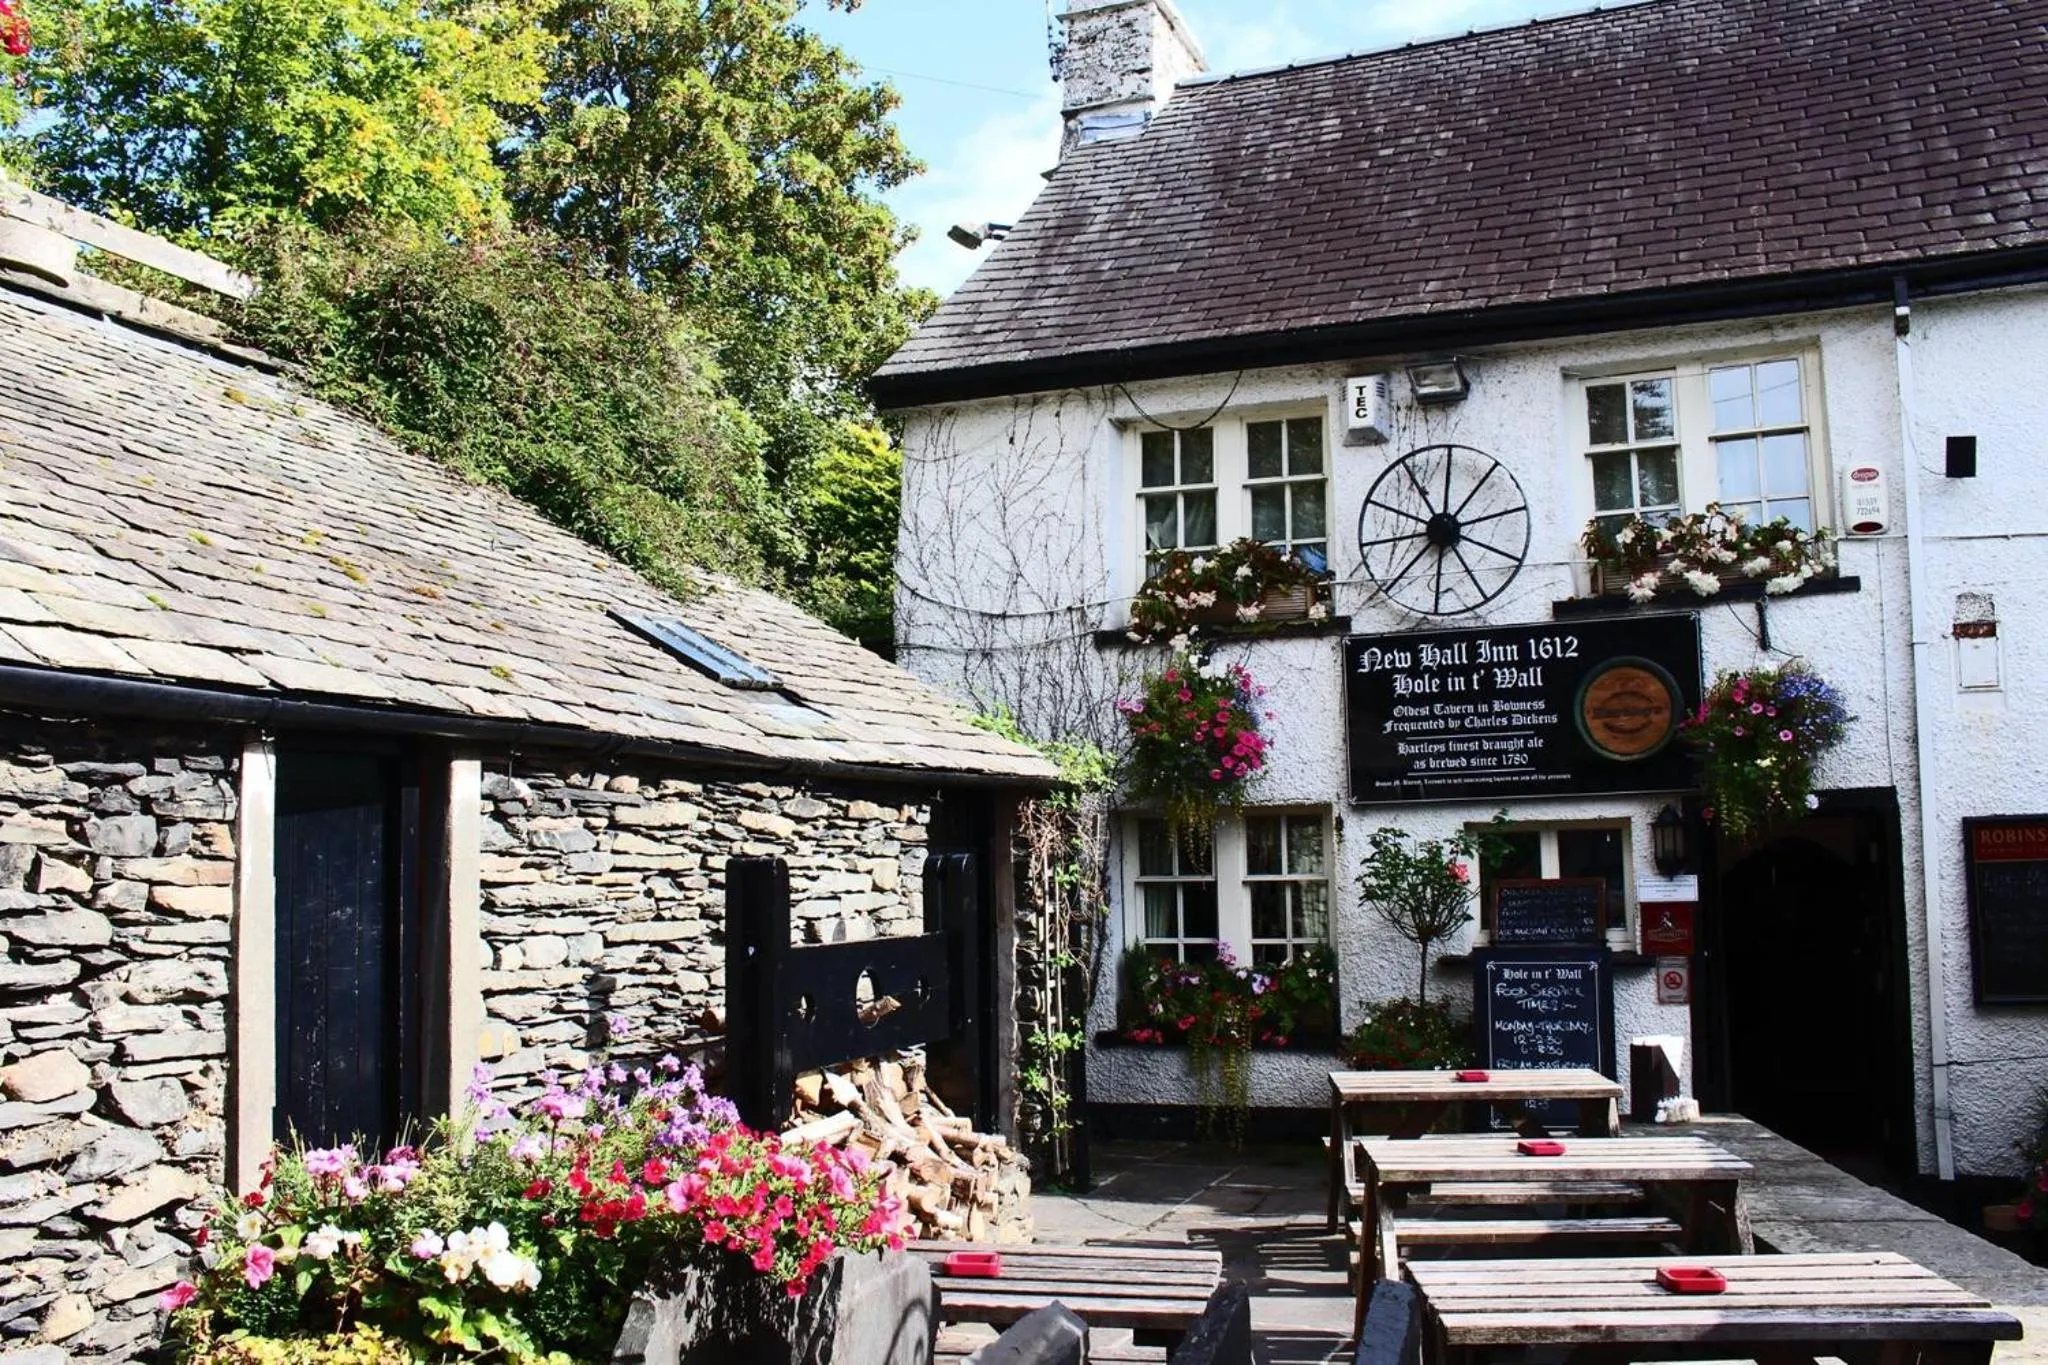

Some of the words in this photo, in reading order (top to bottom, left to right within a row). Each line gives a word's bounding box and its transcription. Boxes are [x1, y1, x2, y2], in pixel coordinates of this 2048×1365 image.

[1355, 385, 1368, 418] TEC
[1357, 647, 1411, 672] New
[1418, 642, 1468, 671] Hall
[1476, 639, 1519, 663] Inn
[1529, 636, 1578, 660] 1612
[1392, 673, 1440, 698] Hole
[1447, 672, 1466, 691] in
[1472, 669, 1484, 690] t'
[1492, 666, 1543, 689] Wall
[1393, 705, 1429, 717] Oldest
[1434, 703, 1474, 715] Tavern
[1478, 703, 1488, 713] in
[1492, 699, 1545, 712] Bowness
[1382, 719, 1445, 734] Frequented
[1448, 717, 1461, 729] by
[1464, 715, 1508, 729] Charles
[1511, 713, 1558, 725] Dickens
[1397, 742, 1446, 757] Hartleys
[1448, 740, 1479, 752] finest
[1482, 738, 1524, 751] draught
[1527, 736, 1544, 748] ale
[1413, 759, 1426, 769] as
[1429, 757, 1467, 768] brewed
[1470, 756, 1498, 767] since
[1503, 968, 1528, 980] Hole
[1531, 970, 1542, 979] in
[1555, 968, 1582, 980] Wall
